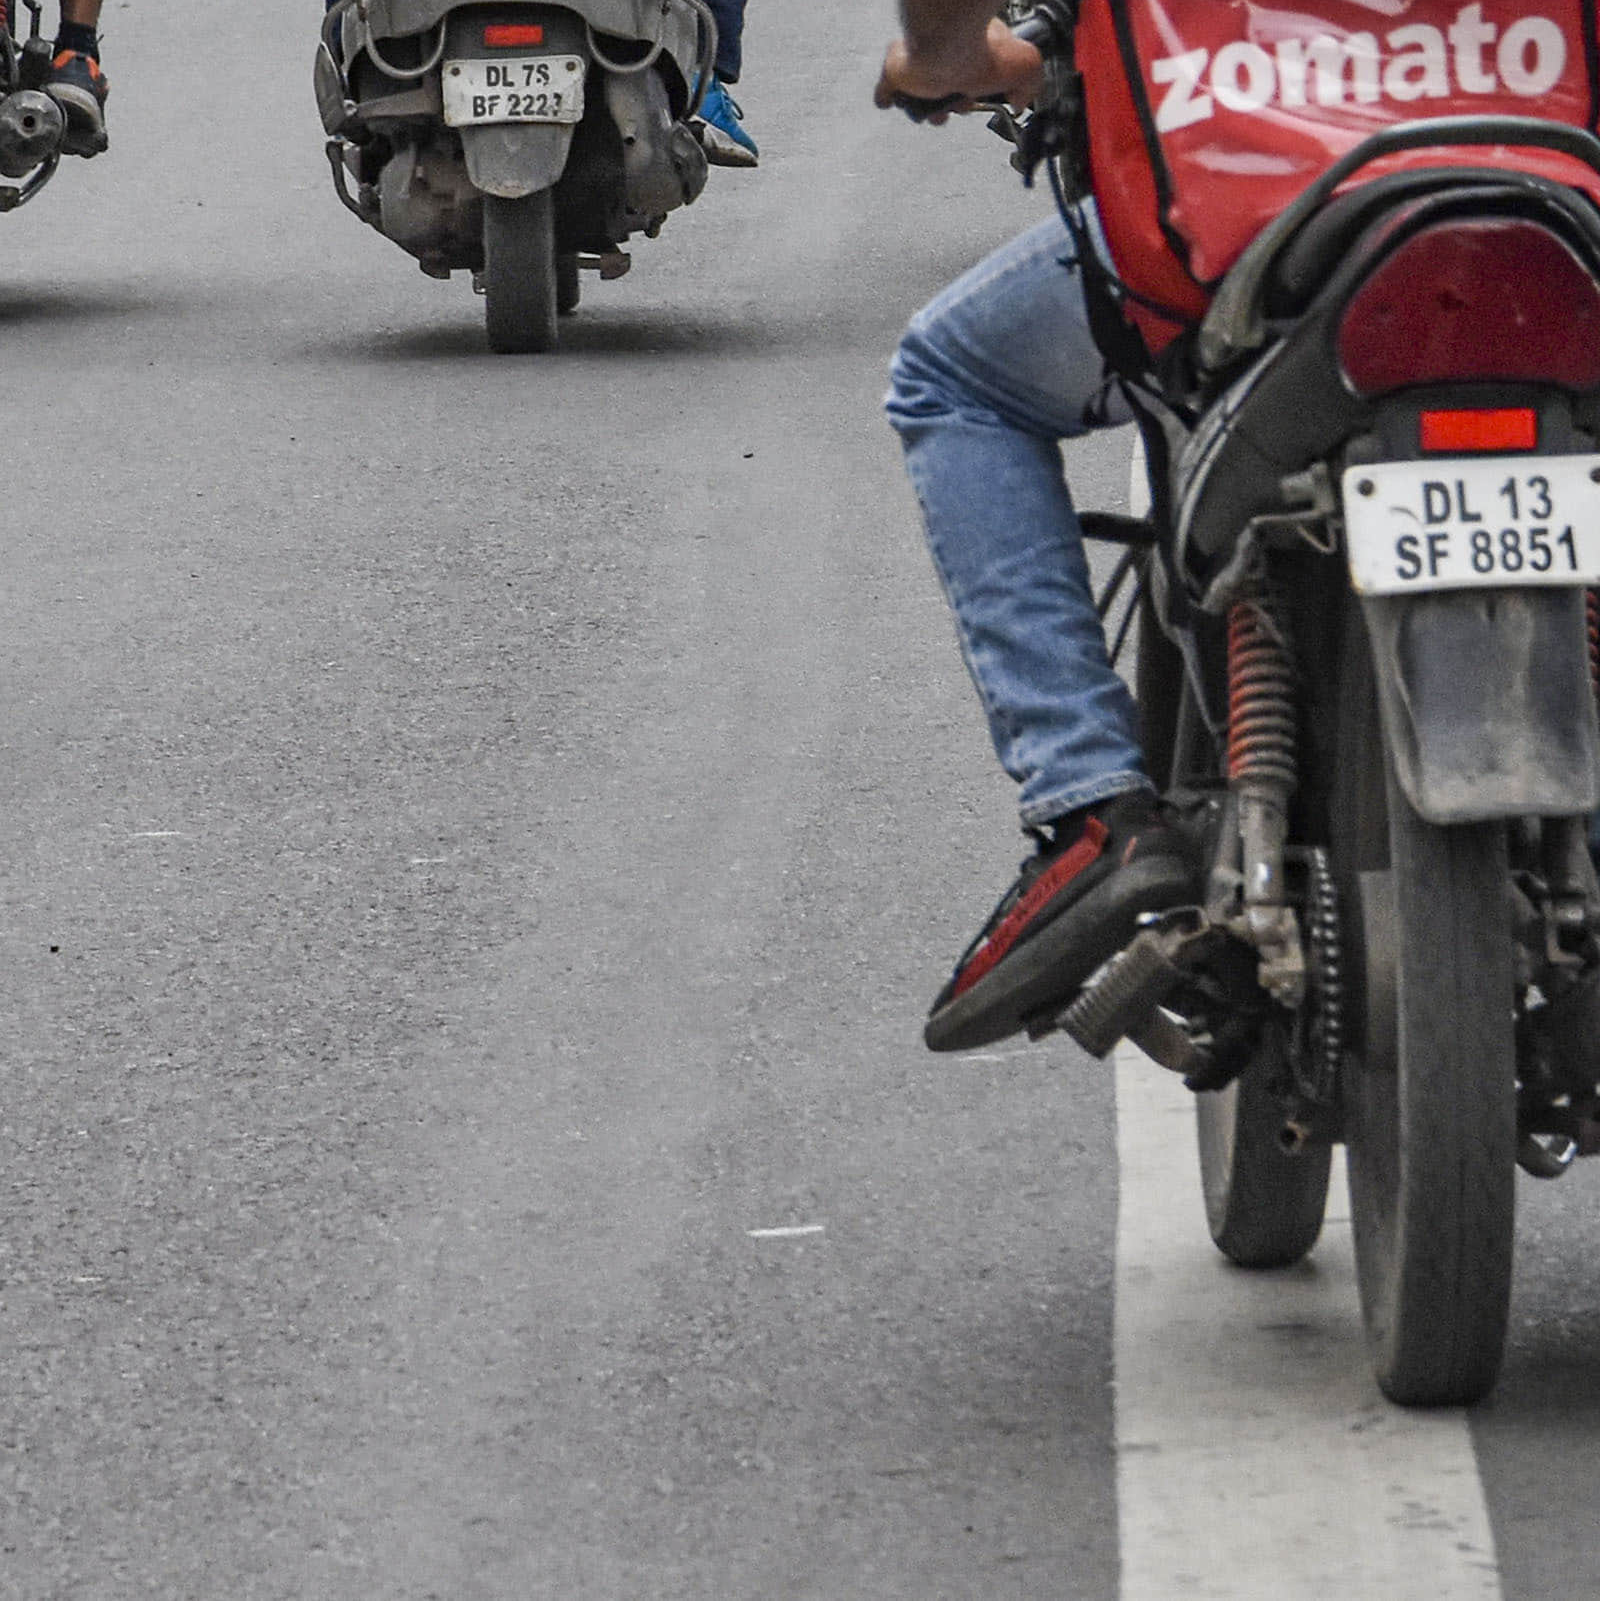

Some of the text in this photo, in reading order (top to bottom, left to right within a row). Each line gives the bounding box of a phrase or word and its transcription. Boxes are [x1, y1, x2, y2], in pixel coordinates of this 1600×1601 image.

[486, 66, 515, 87] DL
[1151, 2, 1567, 134] zomato
[472, 95, 501, 118] BF
[1423, 476, 1553, 524] DL 13
[1396, 526, 1578, 579] SF 8851
